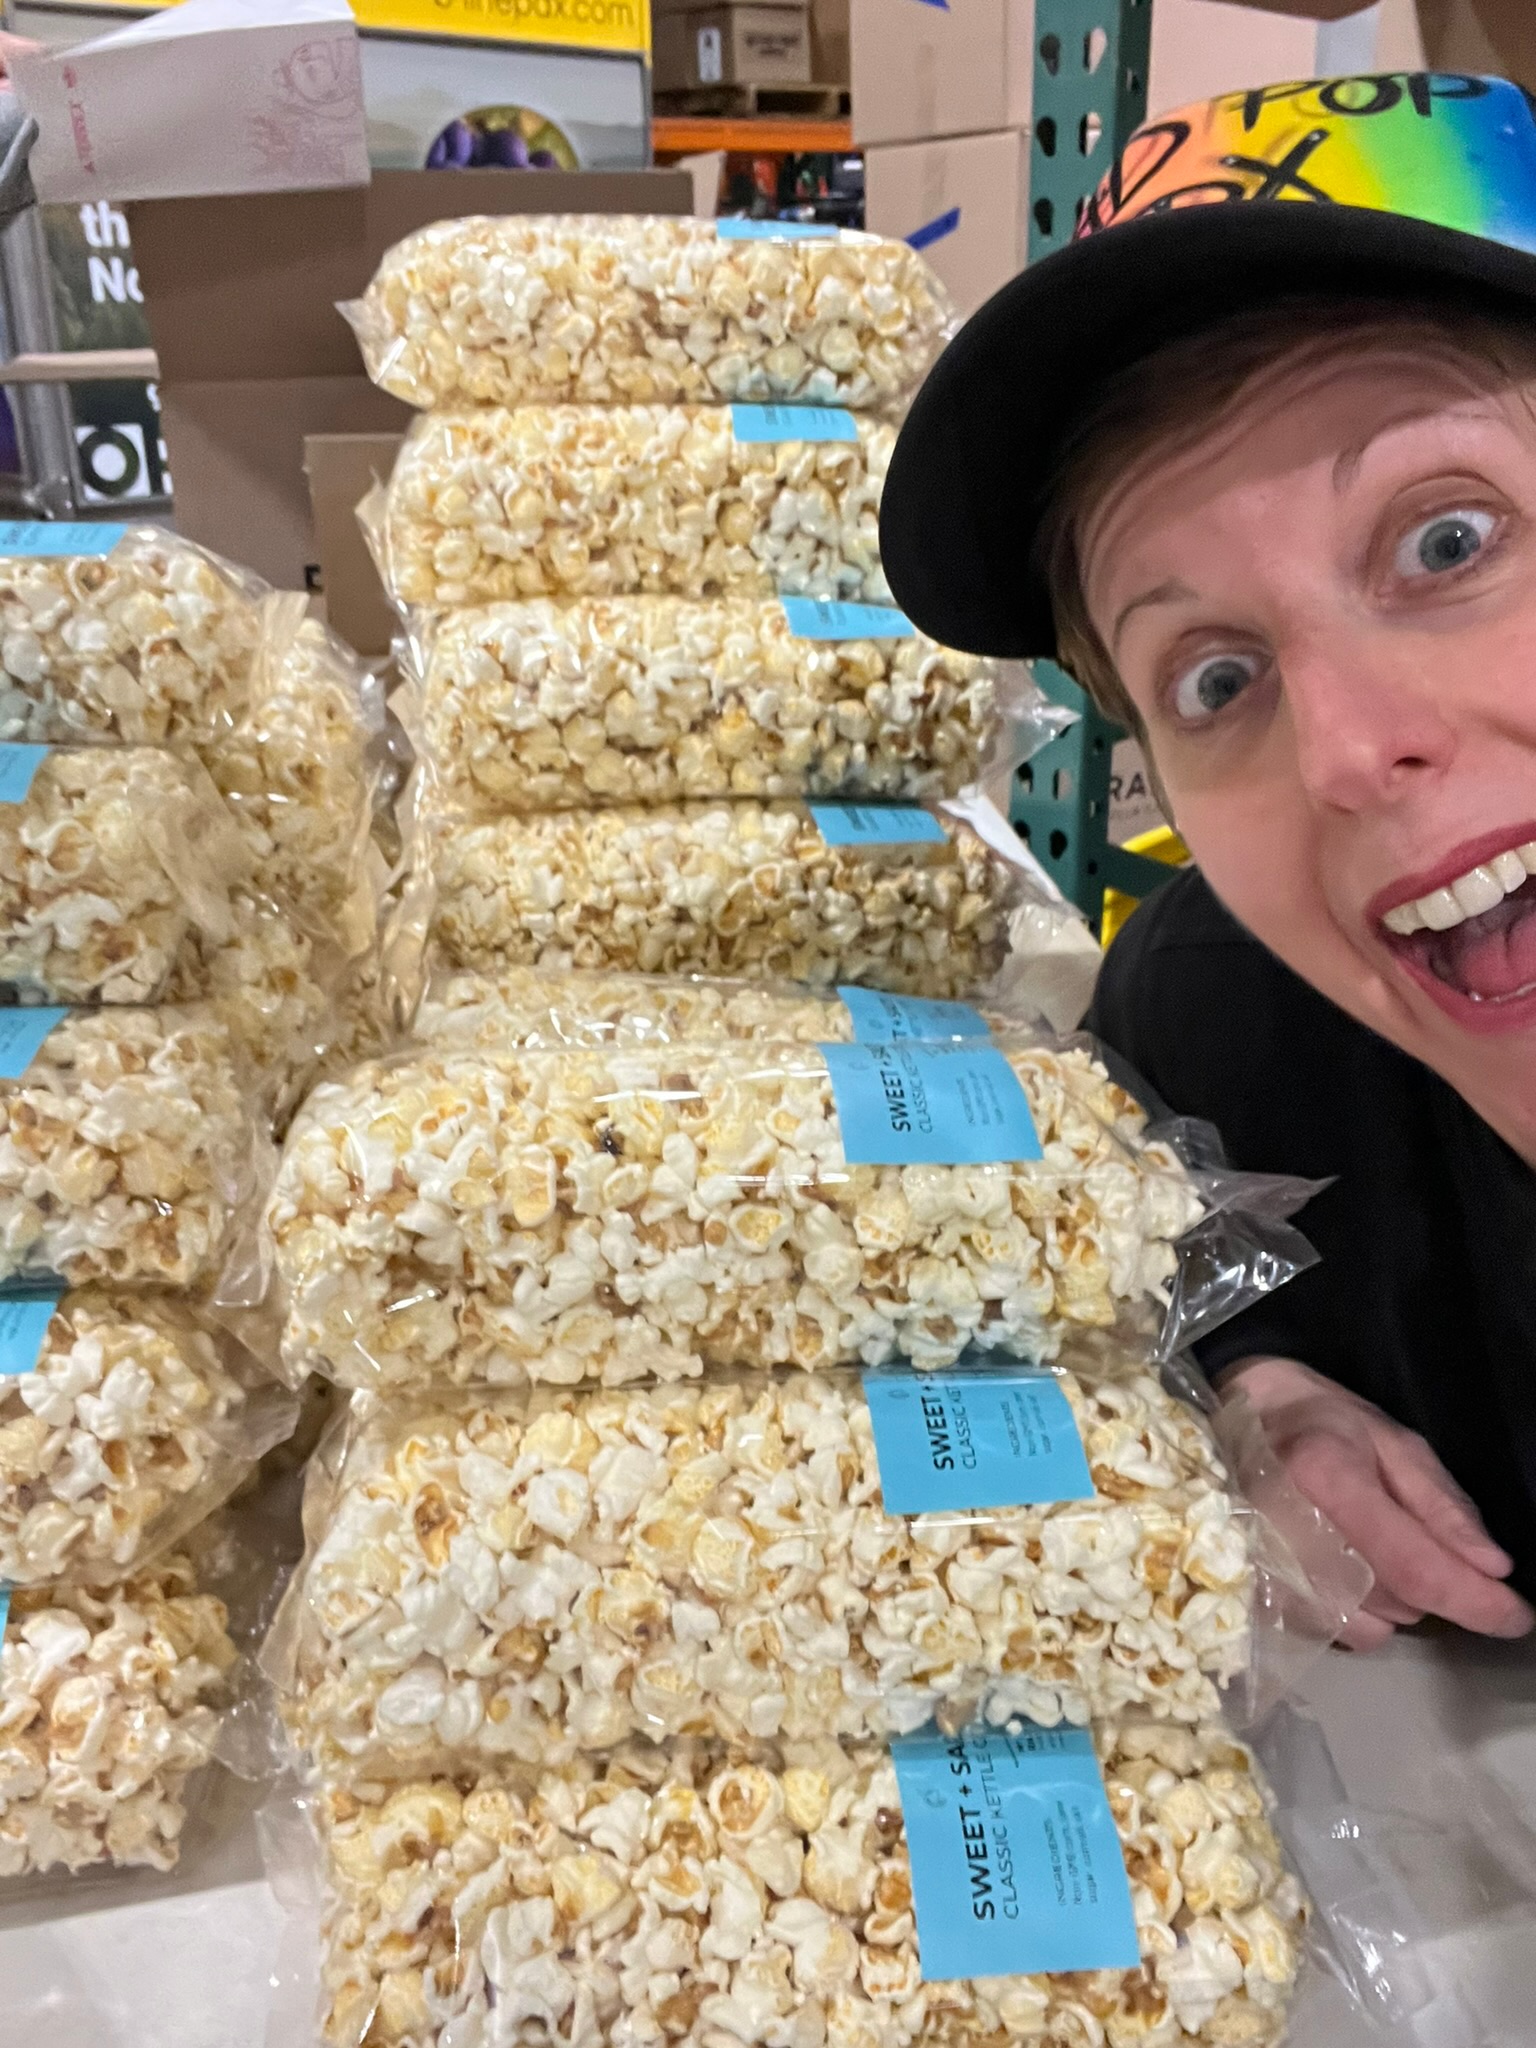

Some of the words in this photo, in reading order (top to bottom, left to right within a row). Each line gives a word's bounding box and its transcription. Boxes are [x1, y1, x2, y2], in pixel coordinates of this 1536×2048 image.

[880, 1070, 911, 1132] SWEET
[921, 1396, 954, 1470] SWEET
[952, 1406, 976, 1469] CLASSIC
[976, 1752, 1004, 1819] KETTLE
[959, 1806, 995, 1920] SWEET
[992, 1825, 1018, 1919] CLASSIC
